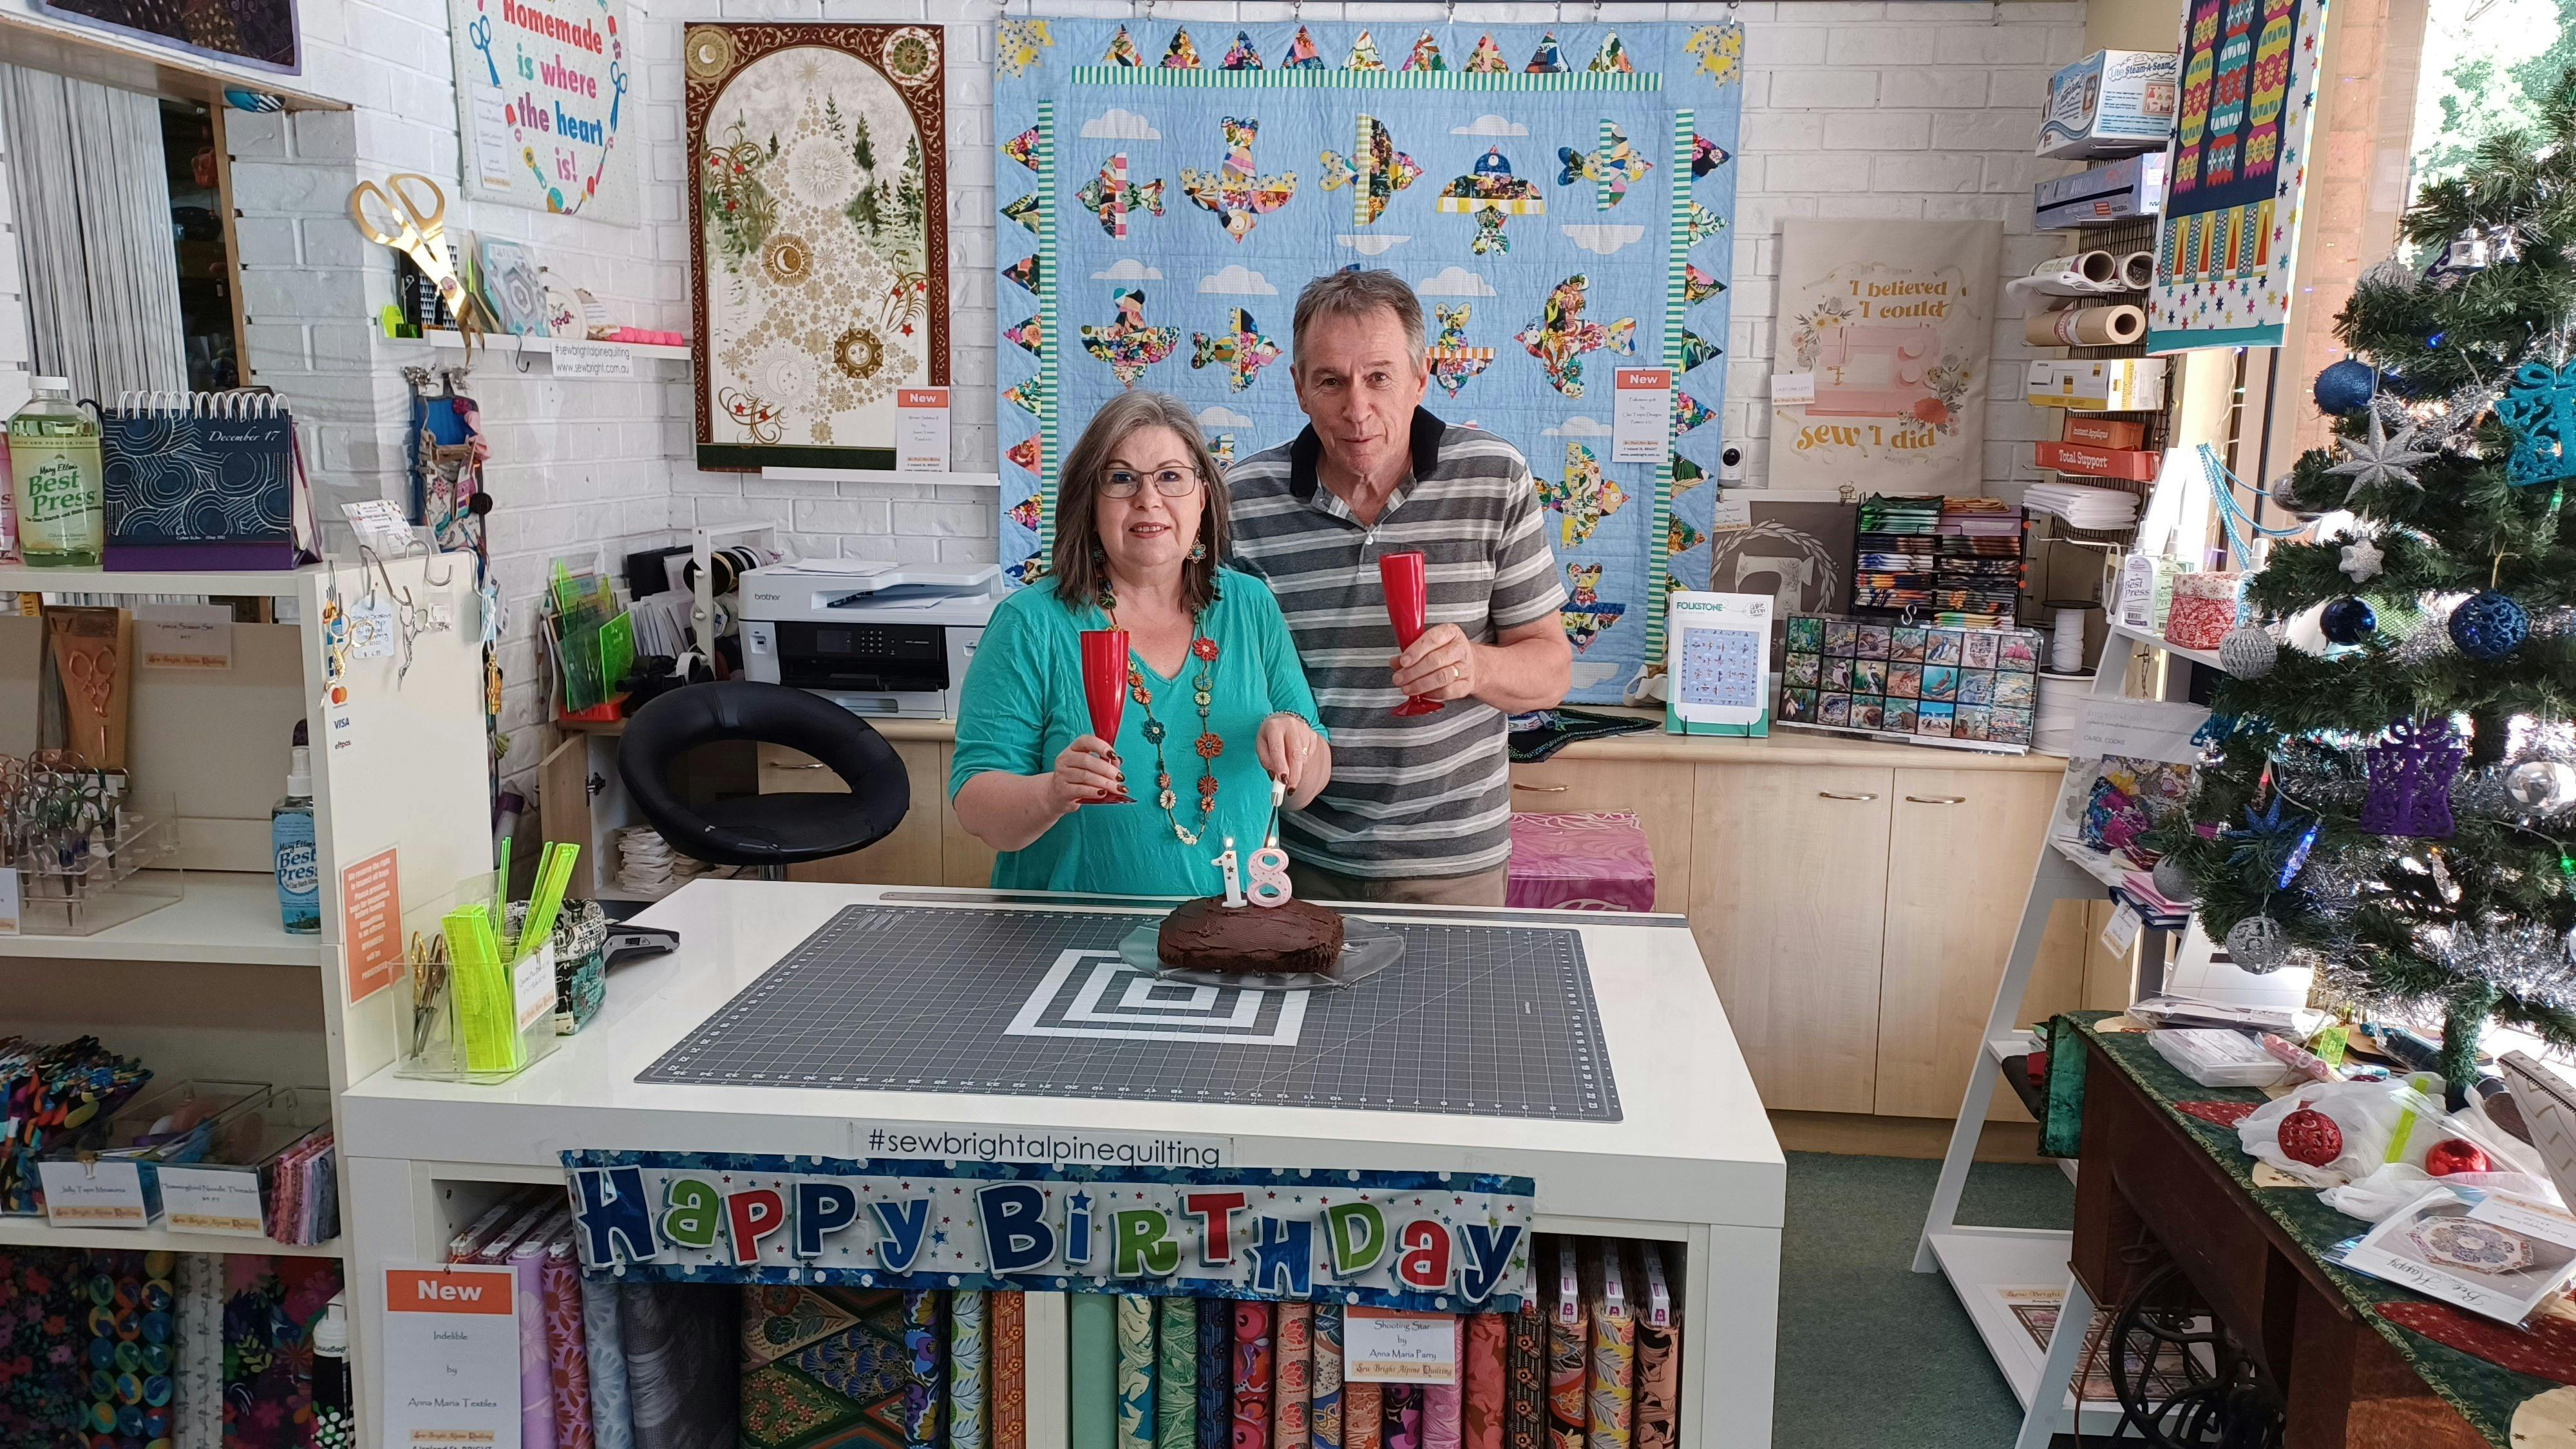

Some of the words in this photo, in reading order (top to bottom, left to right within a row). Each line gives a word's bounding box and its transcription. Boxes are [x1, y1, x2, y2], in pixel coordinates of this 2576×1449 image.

[504, 0, 602, 54] Homemade
[516, 43, 534, 80] is
[540, 53, 596, 99] where
[518, 91, 550, 132] the
[554, 100, 603, 146] heart
[554, 147, 578, 182] is!
[1850, 280, 1860, 296] I
[1868, 280, 1948, 298] believed
[1859, 301, 1870, 318] I
[1880, 300, 1949, 318] could
[1630, 374, 1658, 384] New
[909, 393, 937, 403] New
[209, 426, 260, 442] December
[264, 430, 281, 442] 17
[1797, 425, 1861, 450] sew
[1869, 425, 1882, 446] I
[1891, 428, 1937, 449] did
[2059, 449, 2076, 463] Total
[2077, 451, 2108, 469] Support
[40, 466, 56, 477] Mary
[28, 471, 80, 497] Best
[32, 490, 98, 516] Press
[2125, 580, 2143, 590] Best
[2125, 588, 2152, 598] Press
[1676, 602, 1723, 612] FOLKSTONE
[334, 717, 350, 730] VISA
[335, 739, 351, 750] eftpos
[279, 842, 295, 853] Mary
[279, 849, 316, 869] Best
[1211, 848, 1293, 907] 18
[869, 1129, 1220, 1167] #sewbrightalpinequilting
[2385, 1258, 2440, 1291] Happy
[418, 1280, 482, 1301] New
[1374, 1320, 1410, 1332] Shooting
[1412, 1321, 1430, 1331] Star
[433, 1331, 468, 1340] Indelible
[1397, 1334, 1407, 1345] by
[1368, 1349, 1390, 1358] Anna
[1392, 1349, 1414, 1358] Maria
[1416, 1349, 1437, 1360] Parry
[446, 1365, 457, 1376] by
[1356, 1363, 1370, 1372] Sew
[1374, 1364, 1396, 1374] Bright
[1397, 1365, 1420, 1376] Alpine
[1423, 1364, 1452, 1377] Quilting
[408, 1397, 432, 1407] Anna
[434, 1397, 459, 1408] Maria
[462, 1397, 497, 1408] Textiles
